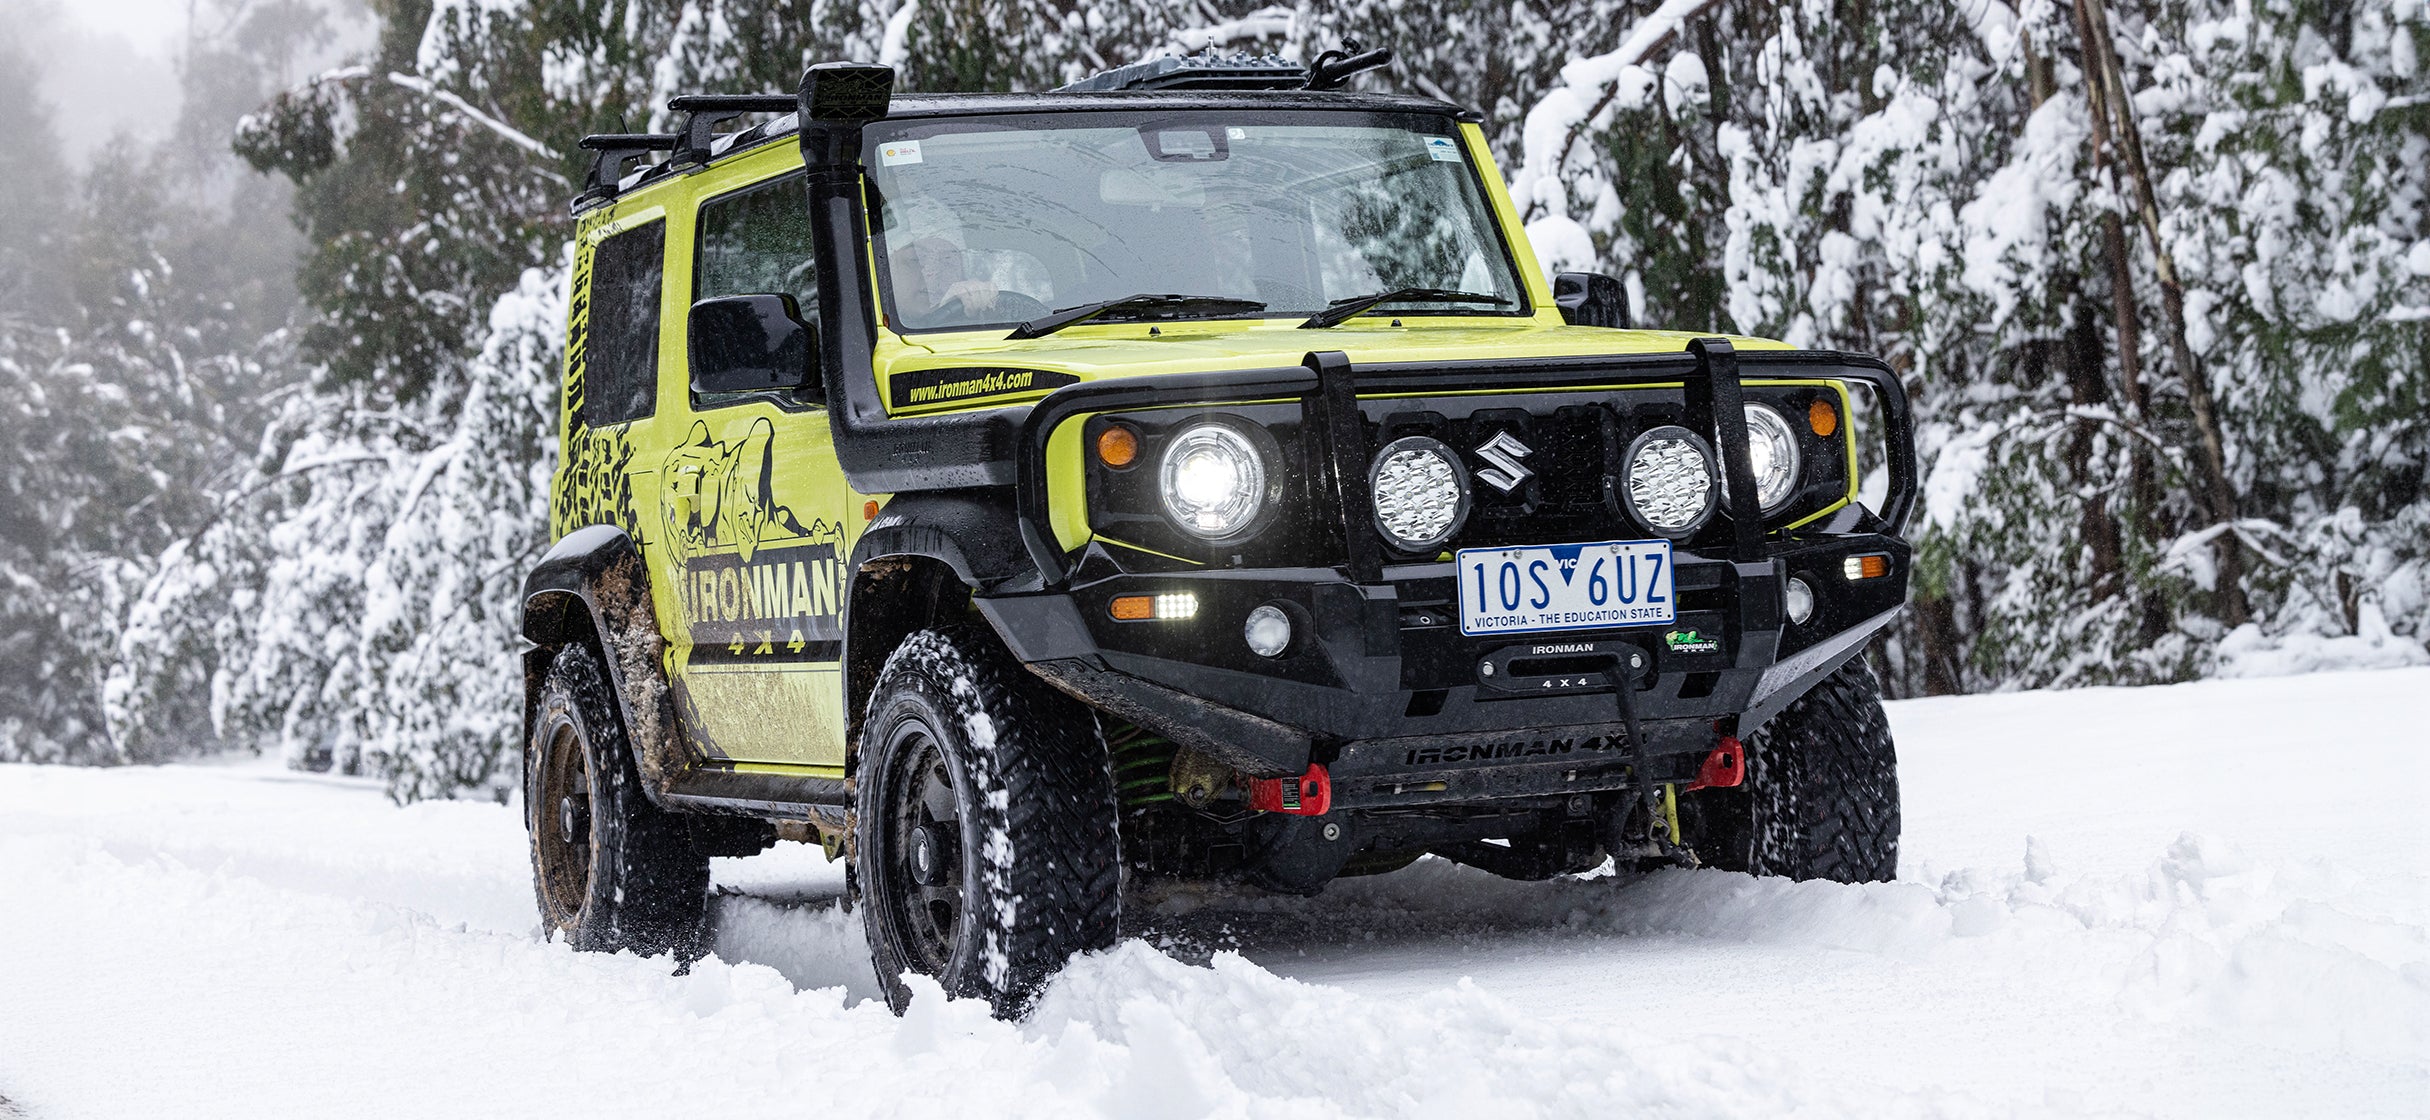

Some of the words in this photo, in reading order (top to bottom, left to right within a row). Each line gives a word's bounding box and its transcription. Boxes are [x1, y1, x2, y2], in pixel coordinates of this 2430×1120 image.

[909, 371, 1034, 403] www.ironman4x4.com
[1555, 558, 1578, 570] VIC
[690, 558, 837, 623] IRONMAN
[1588, 553, 1666, 607] 6UZ
[1474, 615, 1528, 628] VICTORIA
[1538, 613, 1561, 624] THE
[1564, 609, 1628, 623] EDUCATION
[1630, 607, 1663, 619] STATE
[1532, 643, 1594, 655] IRONMAN
[1405, 737, 1574, 766] IRONMAN
